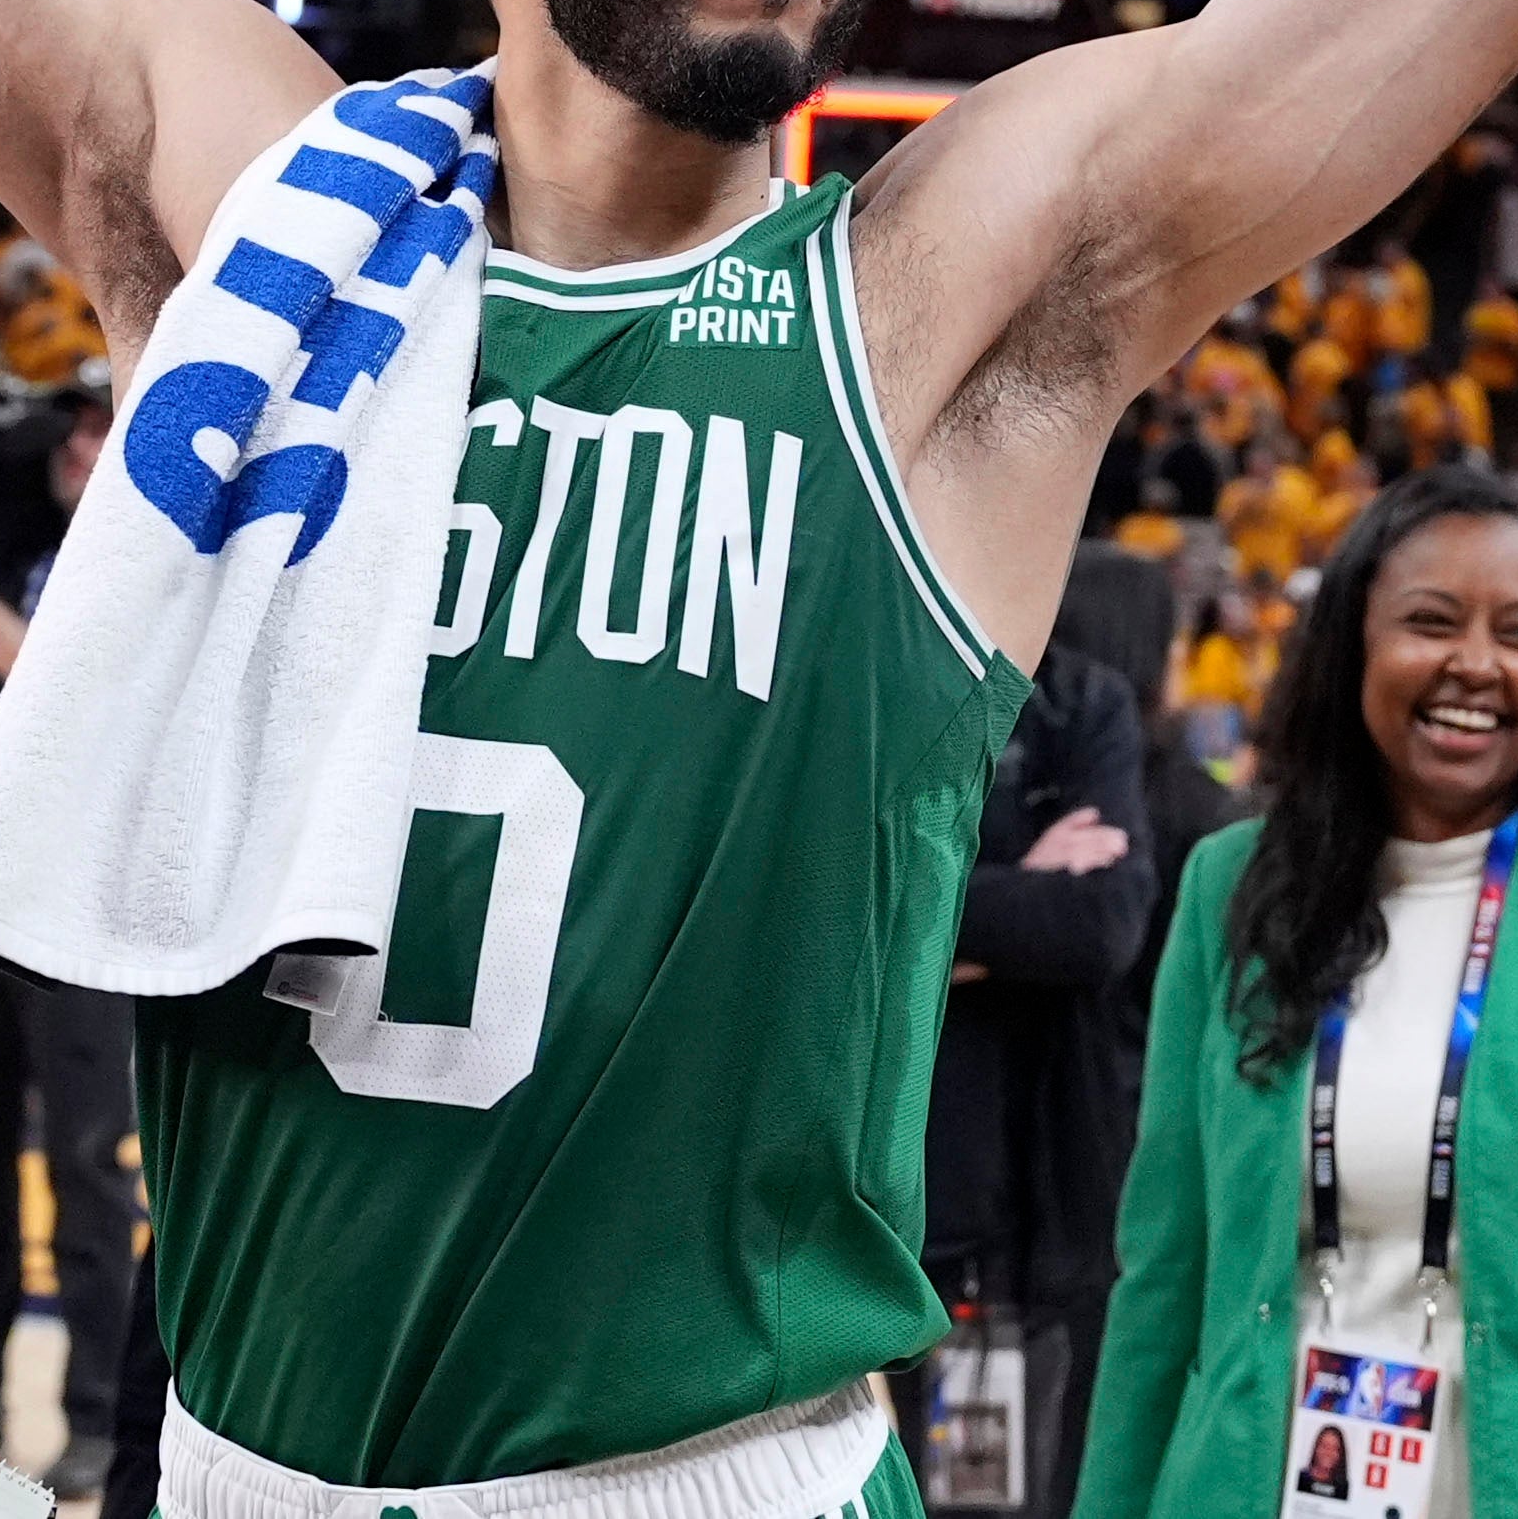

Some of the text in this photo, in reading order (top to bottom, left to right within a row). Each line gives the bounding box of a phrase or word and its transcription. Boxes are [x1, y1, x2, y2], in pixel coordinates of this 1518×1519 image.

[670, 305, 796, 345] PRINT
[678, 256, 796, 309] VISTA
[427, 395, 804, 703] STON
[307, 732, 586, 1110] 0
